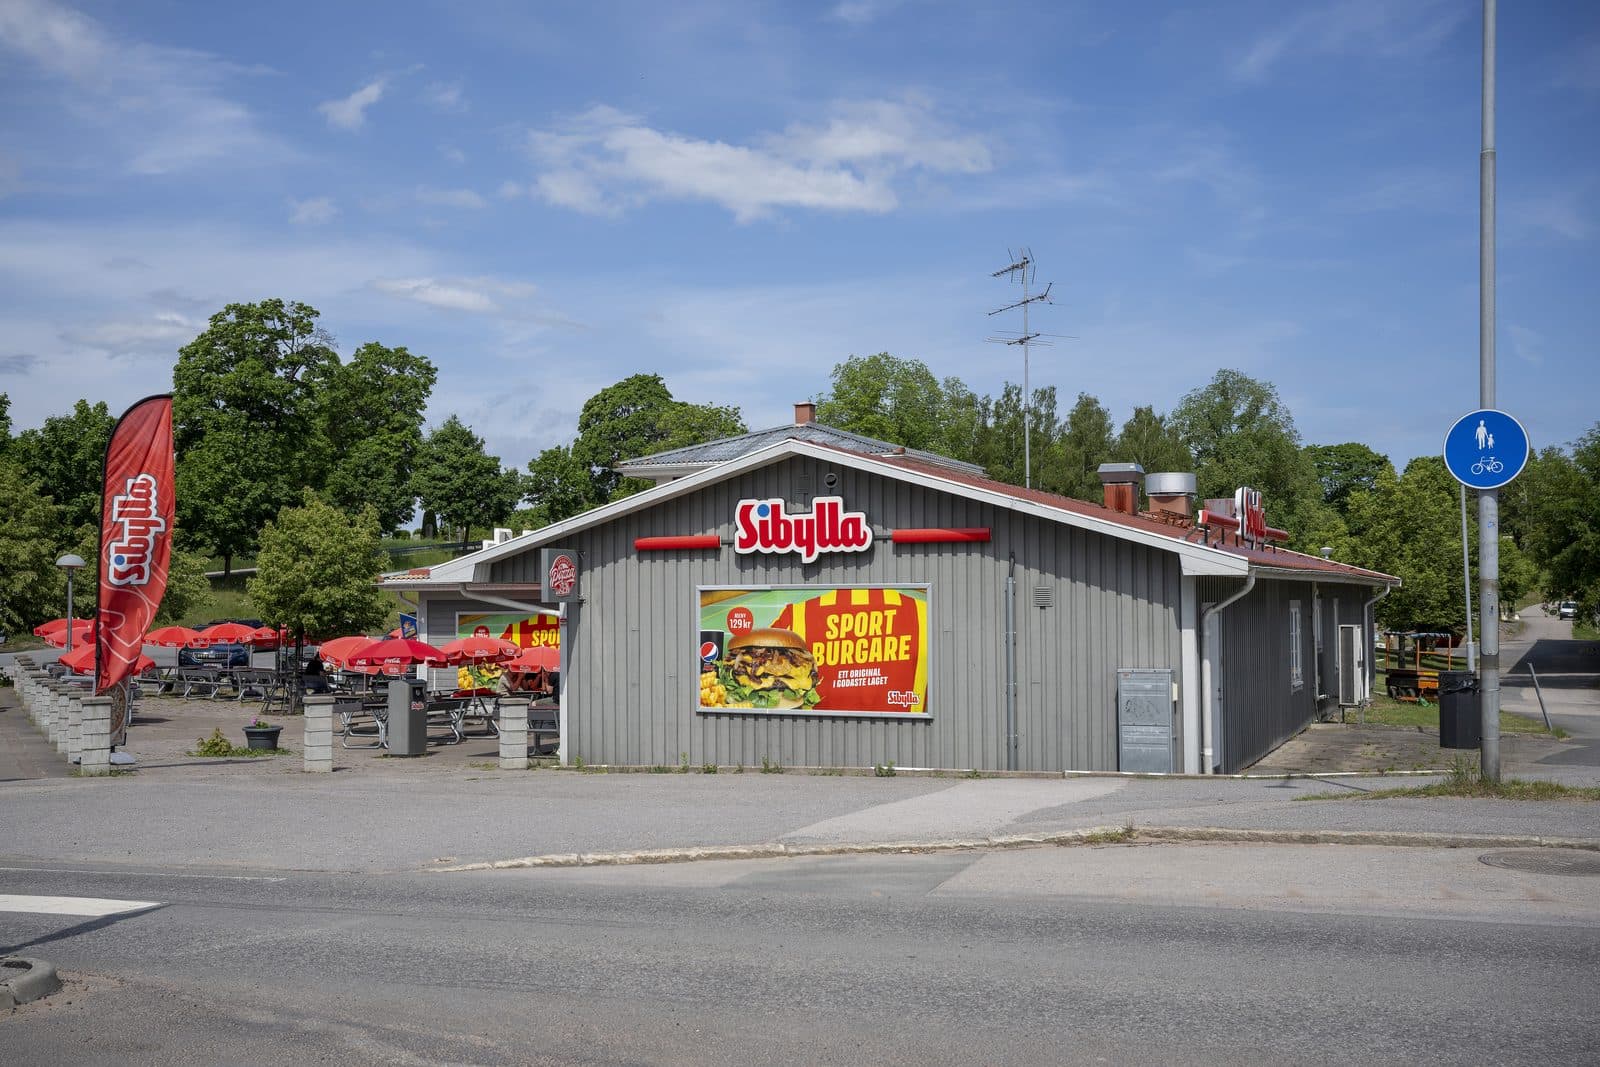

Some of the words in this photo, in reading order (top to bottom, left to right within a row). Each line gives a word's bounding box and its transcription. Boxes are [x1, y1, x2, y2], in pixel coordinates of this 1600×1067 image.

[113, 477, 162, 580] Sibylla
[738, 502, 868, 558] Sibylla
[730, 619, 743, 629] 129
[743, 619, 751, 629] kr
[825, 609, 897, 640] SPORT
[812, 634, 912, 667] BURGARE
[832, 680, 836, 688] I
[836, 677, 867, 688] GODASTE
[867, 676, 888, 686] LAGET
[838, 670, 849, 679] ETT
[849, 668, 881, 678] ORIGINAL
[888, 691, 919, 707] Sibylla
